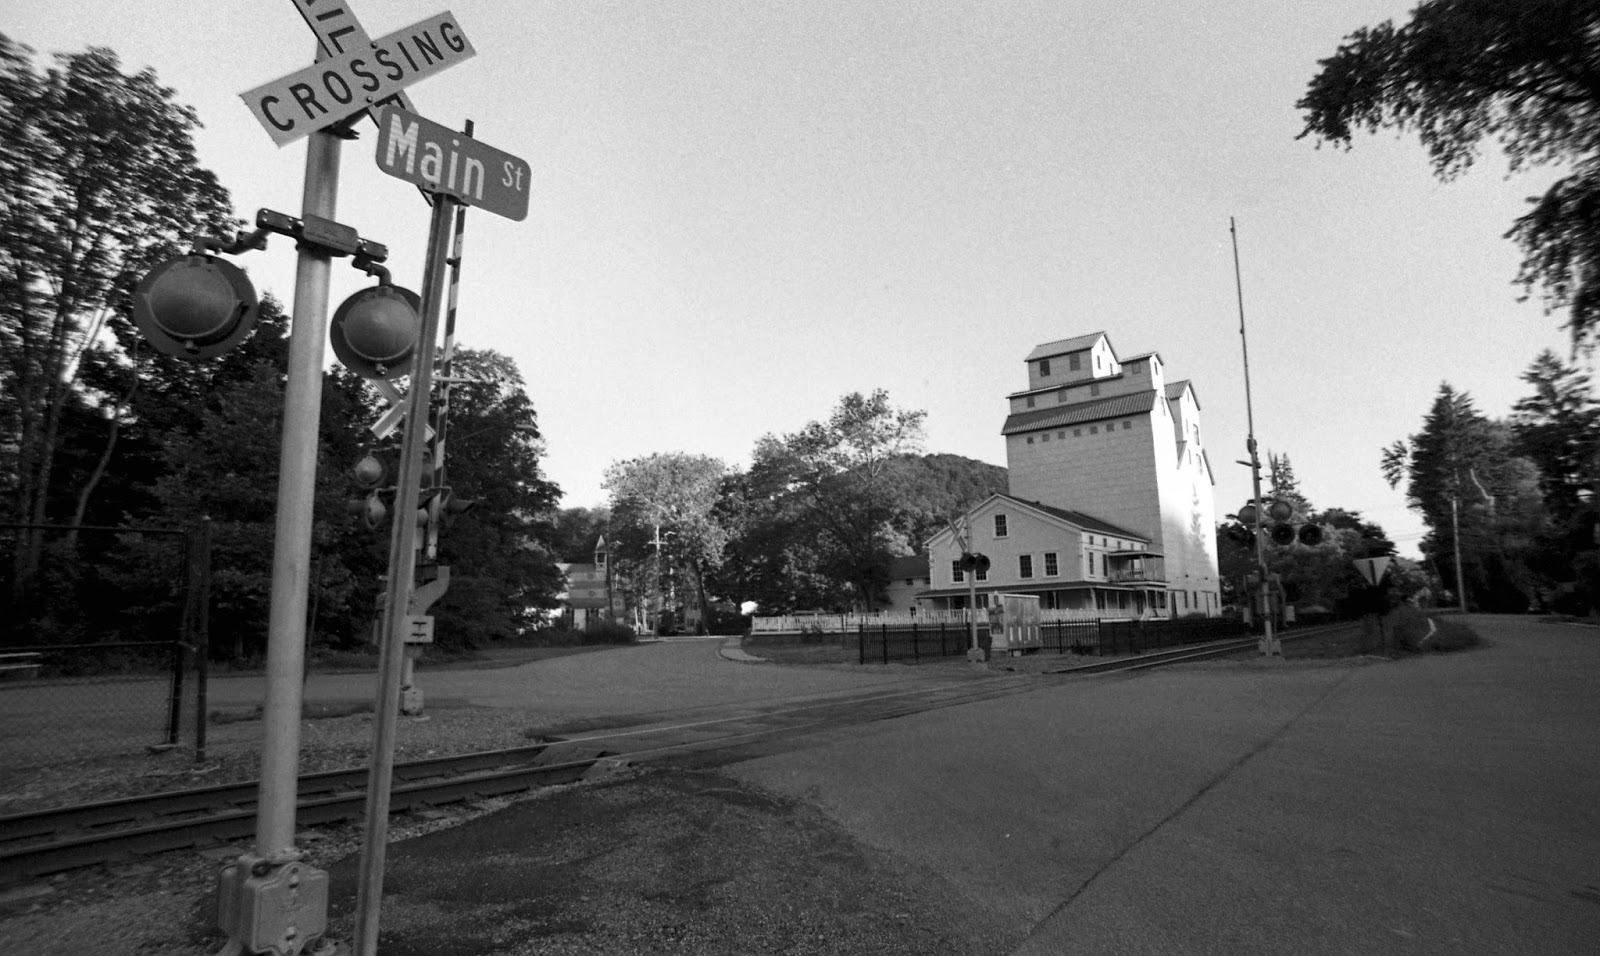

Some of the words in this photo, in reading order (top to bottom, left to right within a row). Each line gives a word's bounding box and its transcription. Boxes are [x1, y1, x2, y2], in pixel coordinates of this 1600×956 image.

[305, 0, 356, 54] IL
[260, 22, 466, 132] CROSSING
[386, 113, 485, 200] Main
[502, 161, 523, 191] St
